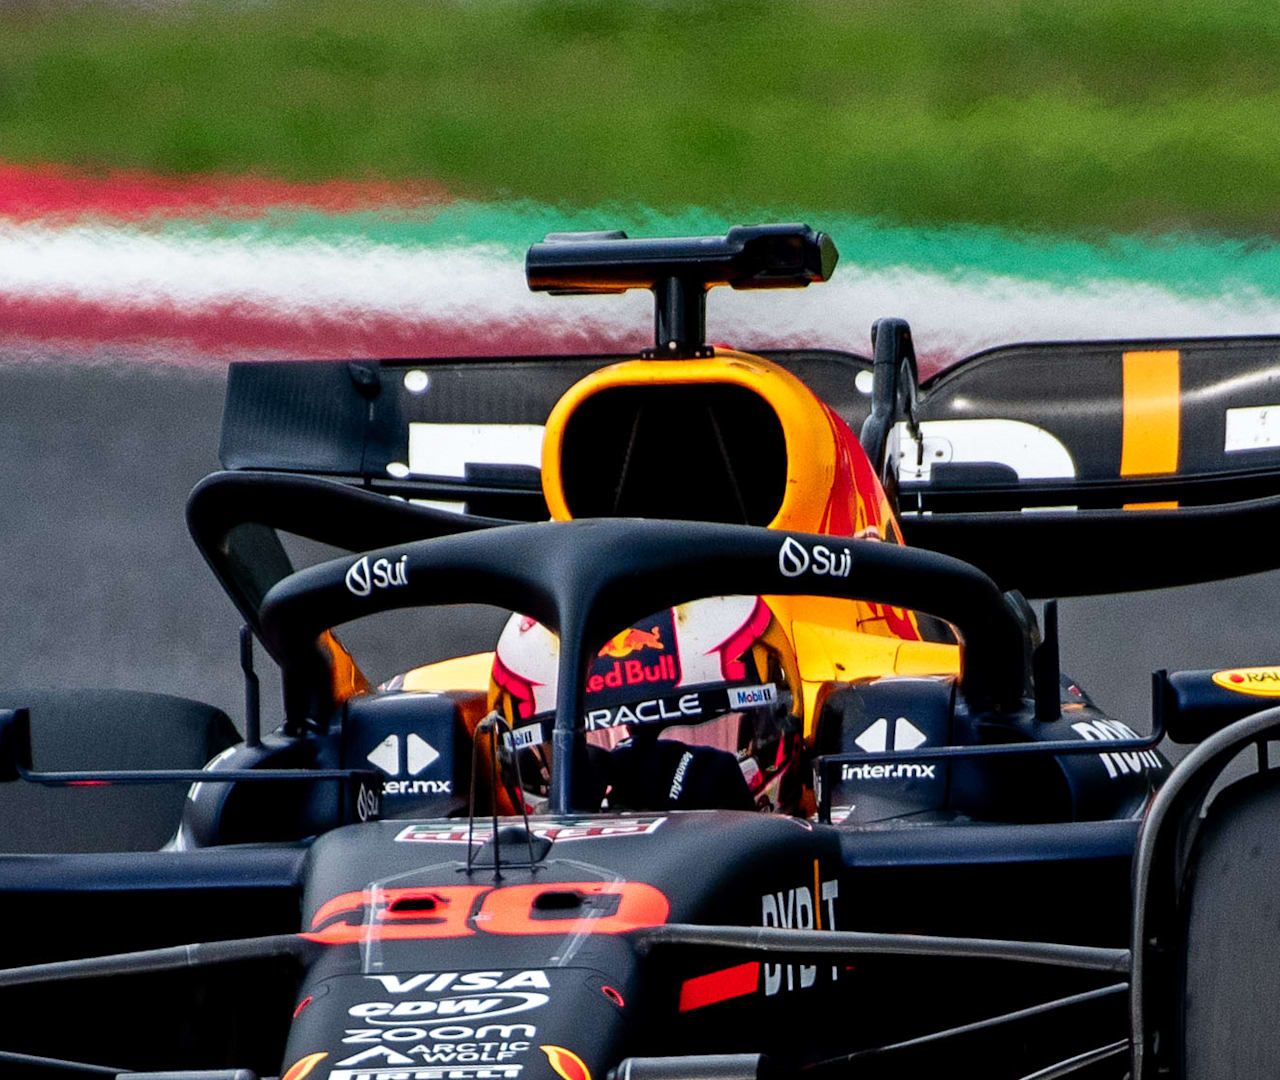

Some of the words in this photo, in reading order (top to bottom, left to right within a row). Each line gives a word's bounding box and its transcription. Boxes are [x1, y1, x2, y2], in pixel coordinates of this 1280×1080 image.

[811, 544, 852, 577] Sui
[373, 554, 408, 588] Sui
[586, 661, 623, 693] ed
[624, 654, 676, 684] Bull
[737, 691, 762, 704] Mobil
[584, 692, 702, 730] RACLE
[841, 763, 936, 780] inter.mx
[381, 780, 451, 795] er.mx
[363, 970, 551, 994] VISA
[347, 998, 504, 1018] CDW
[407, 1041, 532, 1054] ARCTIC
[422, 1051, 517, 1063] WOLF
